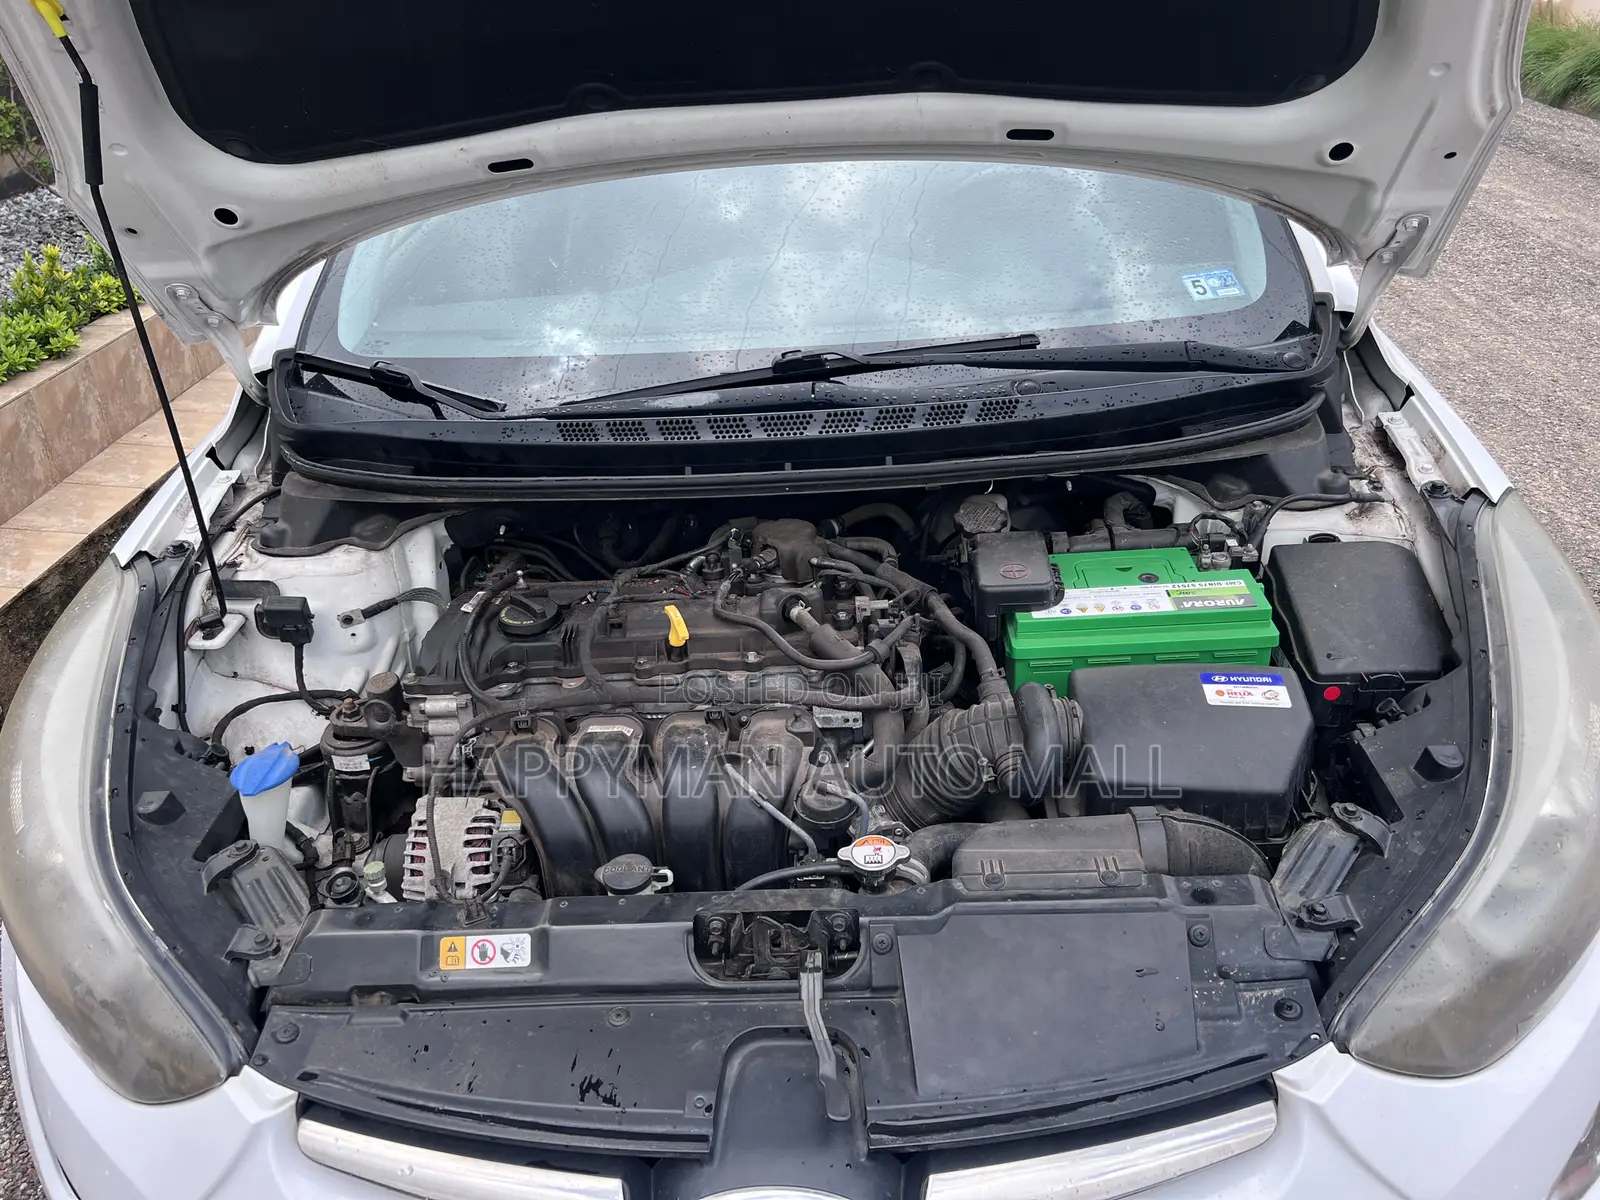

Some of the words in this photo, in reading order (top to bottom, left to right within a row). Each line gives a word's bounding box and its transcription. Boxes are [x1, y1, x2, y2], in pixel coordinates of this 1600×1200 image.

[1191, 279, 1208, 296] 5
[1182, 598, 1245, 608] AURORA
[604, 863, 652, 874] COOLANT
